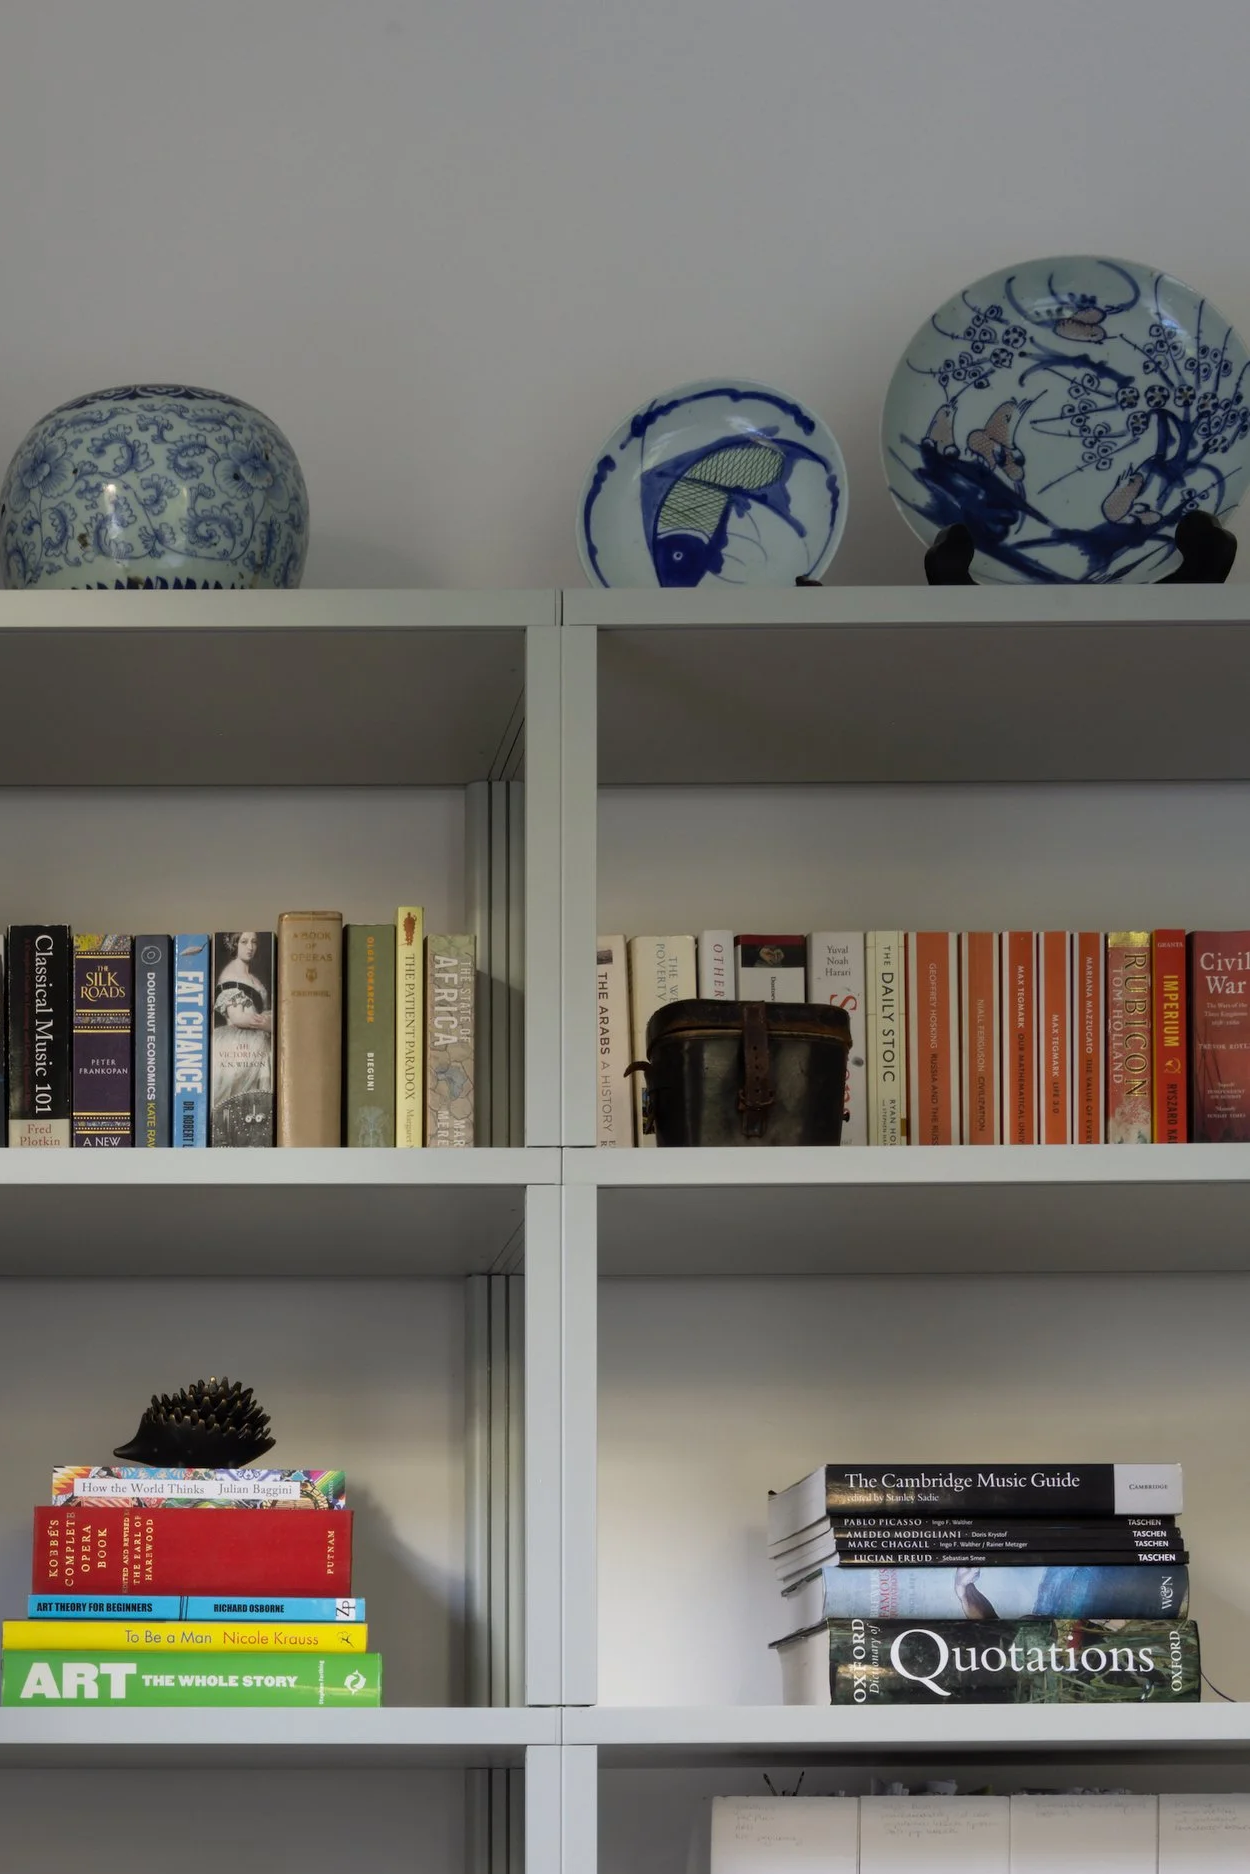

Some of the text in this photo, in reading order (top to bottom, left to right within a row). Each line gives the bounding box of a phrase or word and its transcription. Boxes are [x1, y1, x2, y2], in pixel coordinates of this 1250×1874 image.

[291, 953, 333, 963] OPERAS
[668, 956, 678, 979] THE
[826, 945, 849, 954] Yuval
[826, 957, 849, 965] Noah
[85, 972, 120, 987] SILK
[597, 971, 609, 1000] THE
[825, 968, 851, 977] Harari
[1205, 975, 1247, 995] War
[80, 986, 126, 1001] ROADS
[434, 955, 458, 1046] AFRICA
[460, 961, 471, 1043] THE STATE OF
[1162, 975, 1180, 1048] IMPERIUM
[35, 934, 54, 1114] Classical Music 101
[175, 971, 204, 1094] FAT CHANCE
[405, 953, 415, 1100] THE PATIENT PARADOX
[598, 1005, 611, 1056] ARABS
[881, 945, 896, 1083] THE DAILY STOIC
[1112, 967, 1124, 1084] TOM HOLLAND
[1124, 953, 1147, 1096] RUBICON
[147, 972, 156, 1127] DOUGHNUT ECONOMICS KATE
[929, 963, 939, 1124] GEOFFREY HOSKING RUSSIA AND THE
[78, 1067, 128, 1075] FRANKOPAN
[600, 1060, 611, 1071] A
[600, 1075, 613, 1132] HISTORY
[1166, 1084, 1178, 1124] RYSZARD
[19, 1134, 61, 1147] Plotkin
[27, 1123, 52, 1135] Fred
[82, 1482, 293, 1496] How the World Thinks Julian Baggini
[844, 1472, 1081, 1493] The Cambridge Music Guide
[134, 1515, 141, 1528] OF
[846, 1531, 891, 1539] AMEDEO
[894, 1531, 962, 1539] MODIGLIANI
[987, 1531, 1008, 1539] Krystof
[81, 1525, 92, 1572] OPERA
[97, 1528, 107, 1568] BOOK
[145, 1519, 153, 1581] HAREWOOD
[327, 1530, 335, 1574] PUTNAM
[36, 1602, 285, 1613] ART THEORY FOR BEGINNERS RICHARD OSBORNE
[125, 1630, 319, 1645] To Be a Man Nicole Krauss
[19, 1661, 298, 1699] ART THE WHOLE STORY
[851, 1619, 866, 1703] OXFORD
[890, 1629, 1155, 1697] Quotations
[1171, 1630, 1183, 1692] OXFORD
